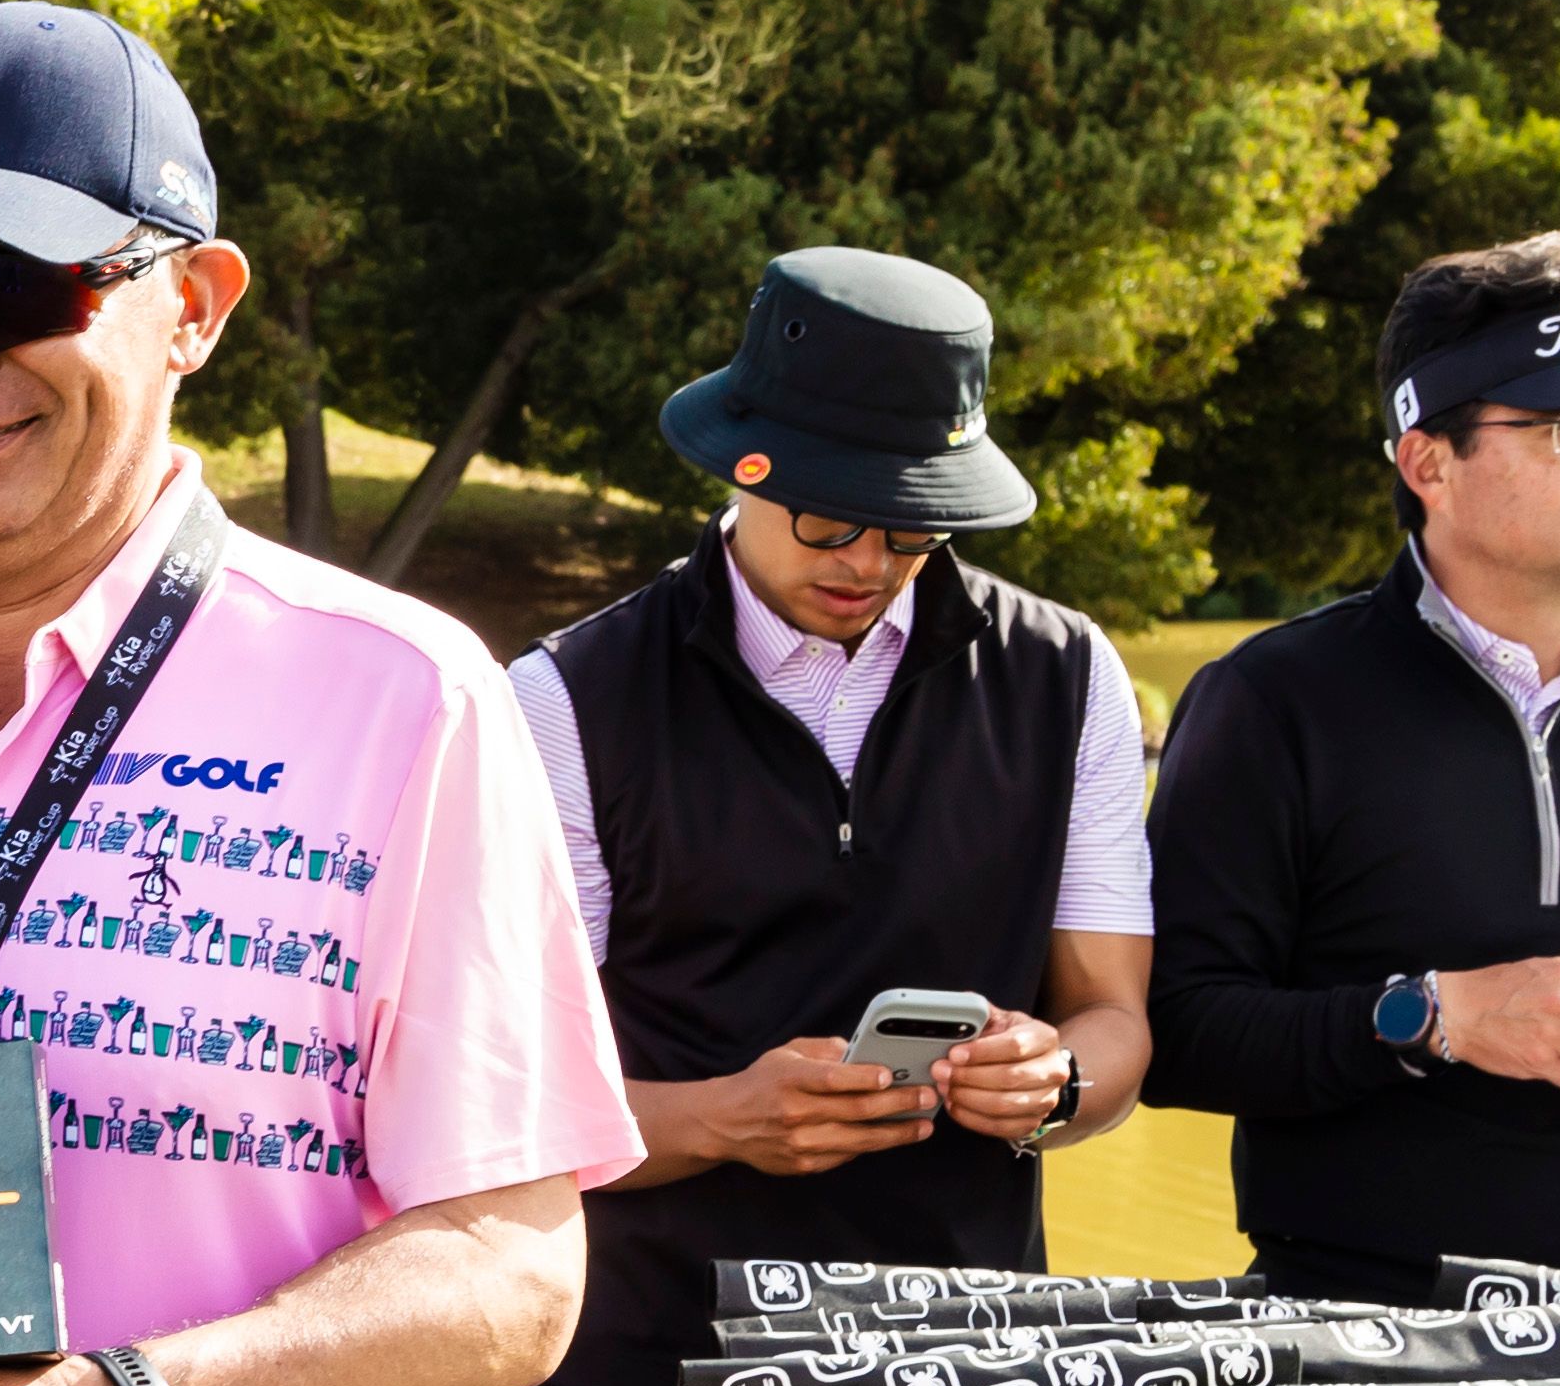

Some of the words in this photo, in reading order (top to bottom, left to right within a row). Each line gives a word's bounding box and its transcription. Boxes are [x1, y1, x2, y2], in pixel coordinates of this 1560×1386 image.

[150, 615, 174, 640] Cup
[110, 635, 142, 668] Kia
[54, 729, 86, 764] Kia
[72, 733, 101, 769] Ryder
[95, 705, 119, 732] Cup
[162, 753, 285, 795] GOLF
[16, 831, 45, 867] Ryder
[38, 802, 62, 829] Cup
